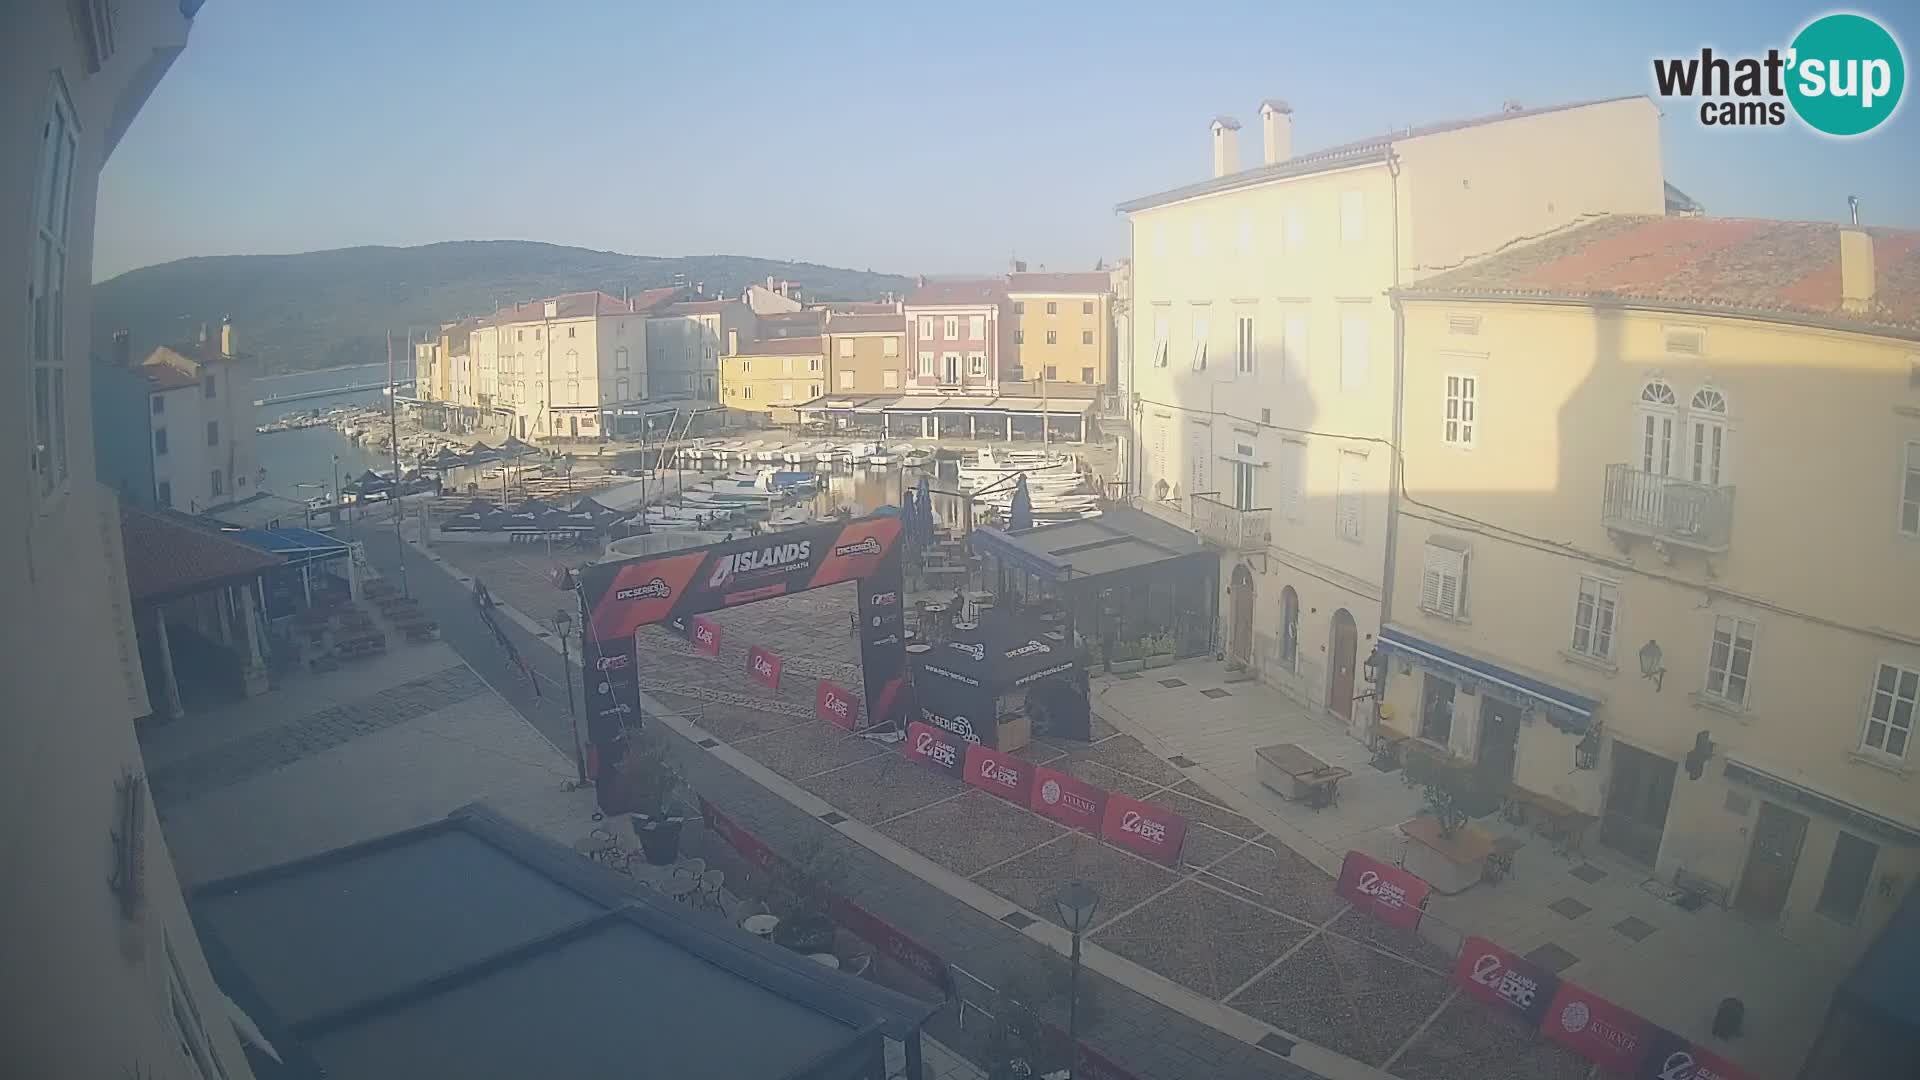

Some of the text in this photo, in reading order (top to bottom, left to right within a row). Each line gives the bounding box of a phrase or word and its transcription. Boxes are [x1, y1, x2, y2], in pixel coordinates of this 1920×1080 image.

[733, 540, 811, 573] ISLANDS
[933, 747, 956, 766] EPIC
[1140, 825, 1166, 842] EPIC
